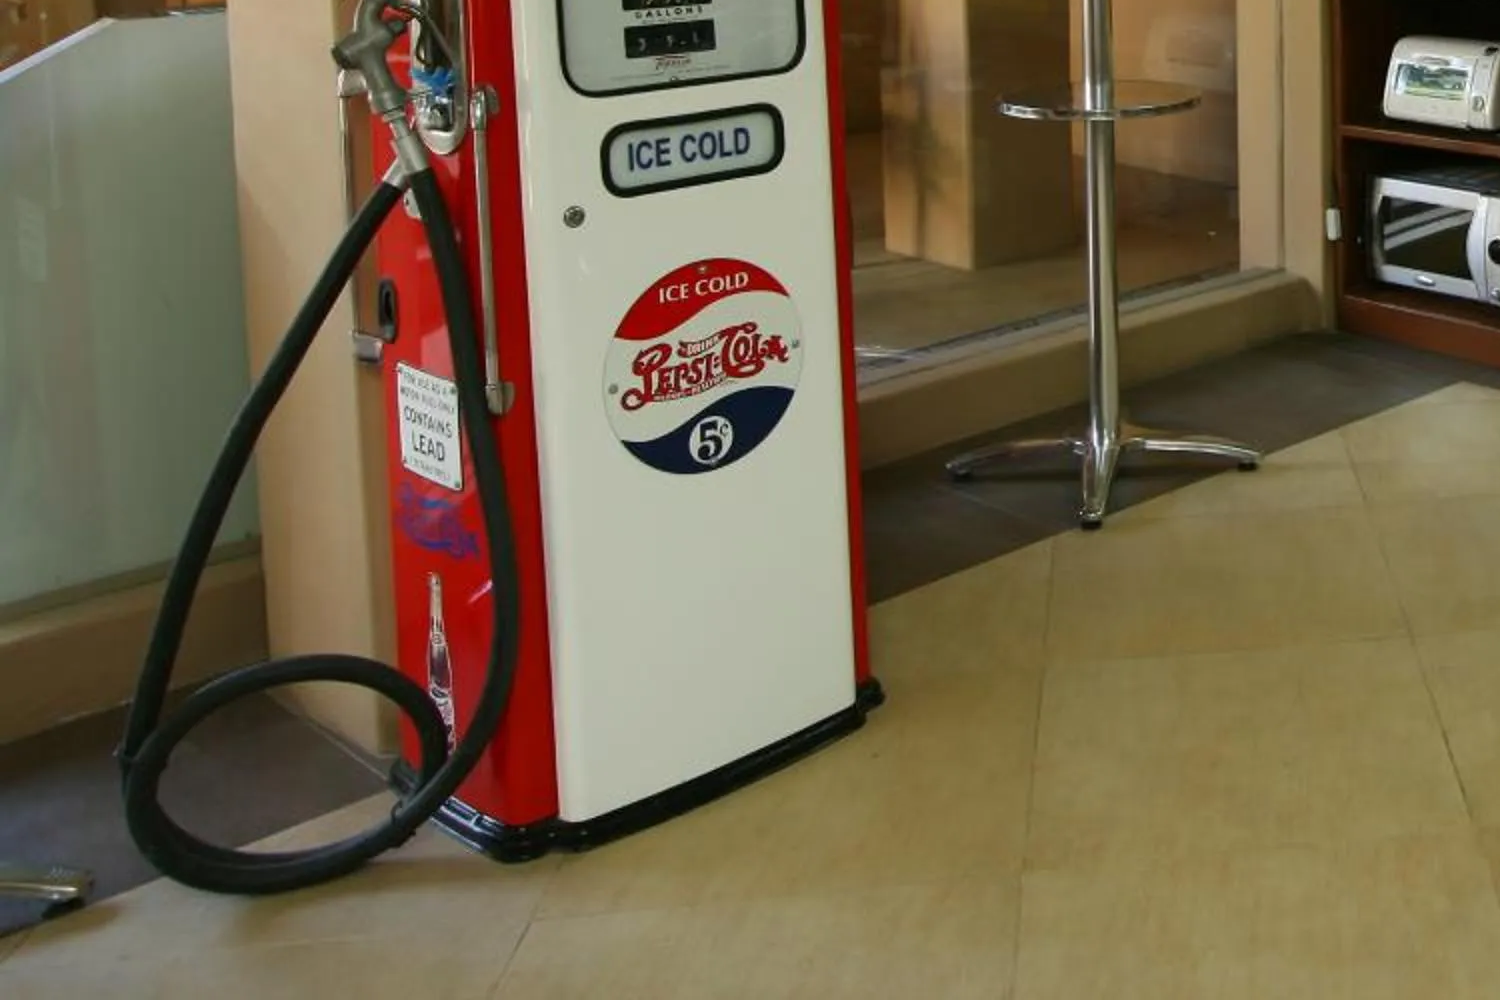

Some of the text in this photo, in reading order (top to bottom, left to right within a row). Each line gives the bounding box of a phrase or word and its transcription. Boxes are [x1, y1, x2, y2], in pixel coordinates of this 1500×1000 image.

[635, 6, 704, 20] GALLONS
[628, 127, 750, 173] ICE COLD
[658, 271, 750, 305] ICE COLD
[404, 405, 453, 439] CONTAINS
[411, 429, 446, 462] LEAD
